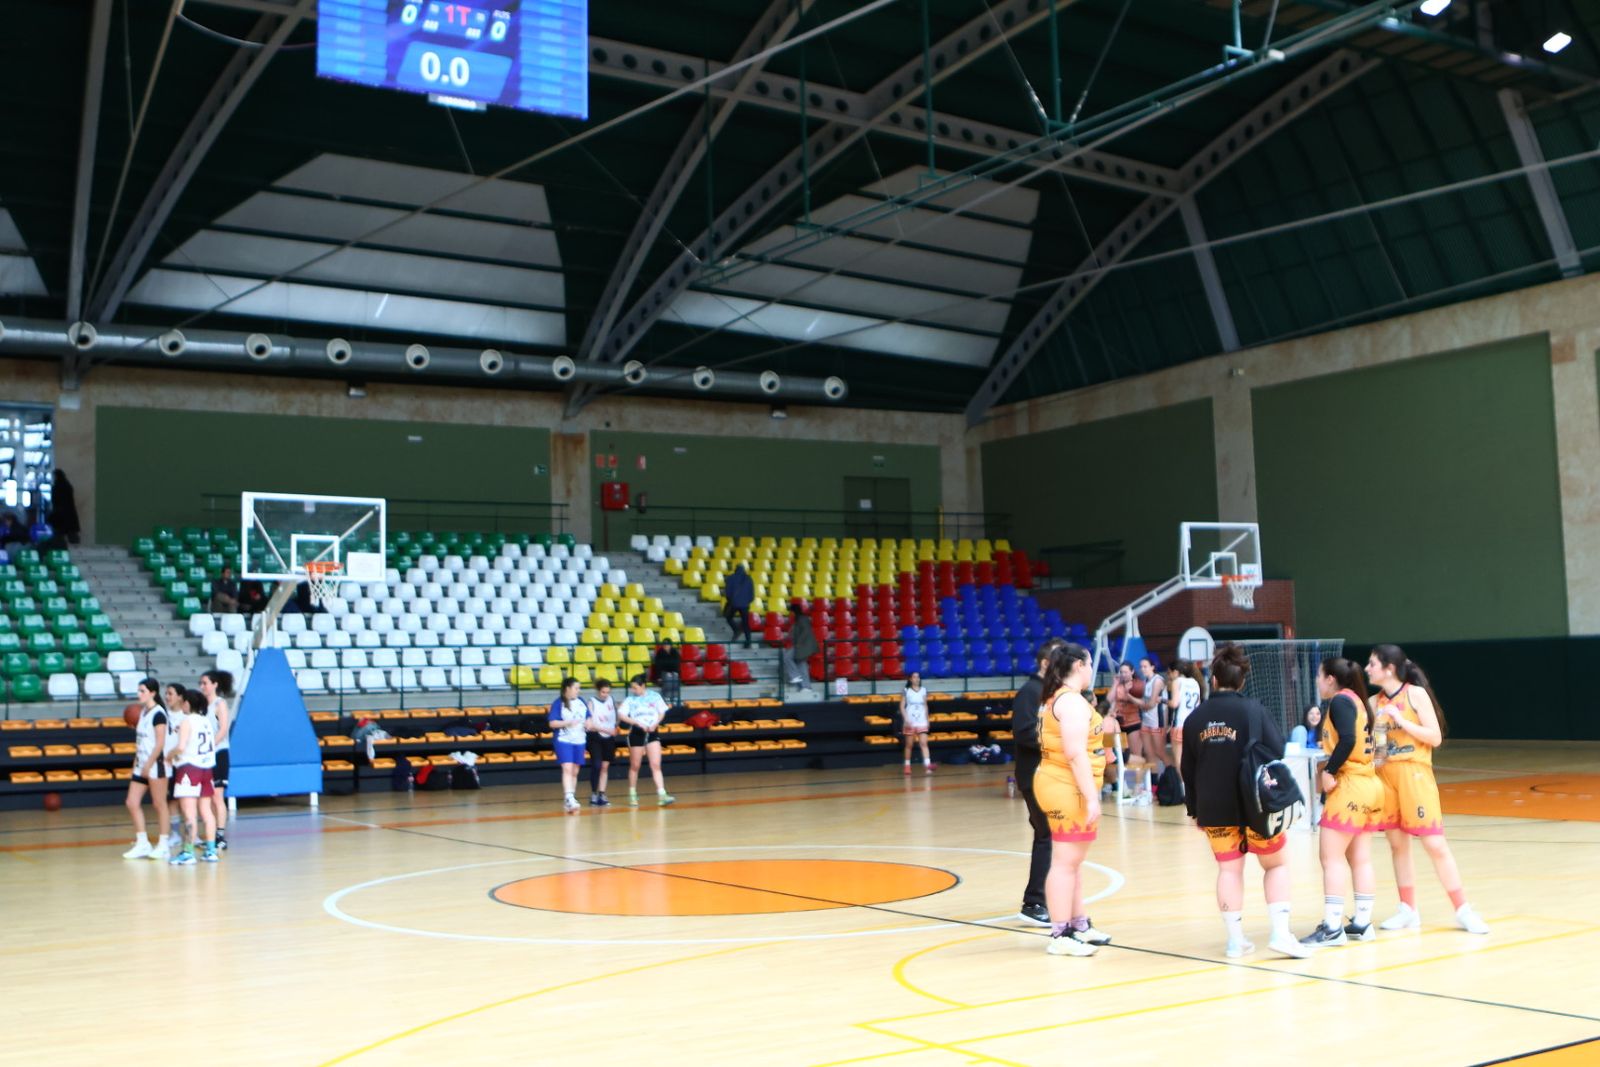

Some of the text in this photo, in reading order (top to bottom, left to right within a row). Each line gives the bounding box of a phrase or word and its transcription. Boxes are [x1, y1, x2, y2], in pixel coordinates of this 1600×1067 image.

[402, 4, 418, 25] 0
[445, 5, 471, 26] 1T
[491, 21, 506, 41] 0
[421, 51, 470, 87] 0.0
[1417, 806, 1425, 819] 6
